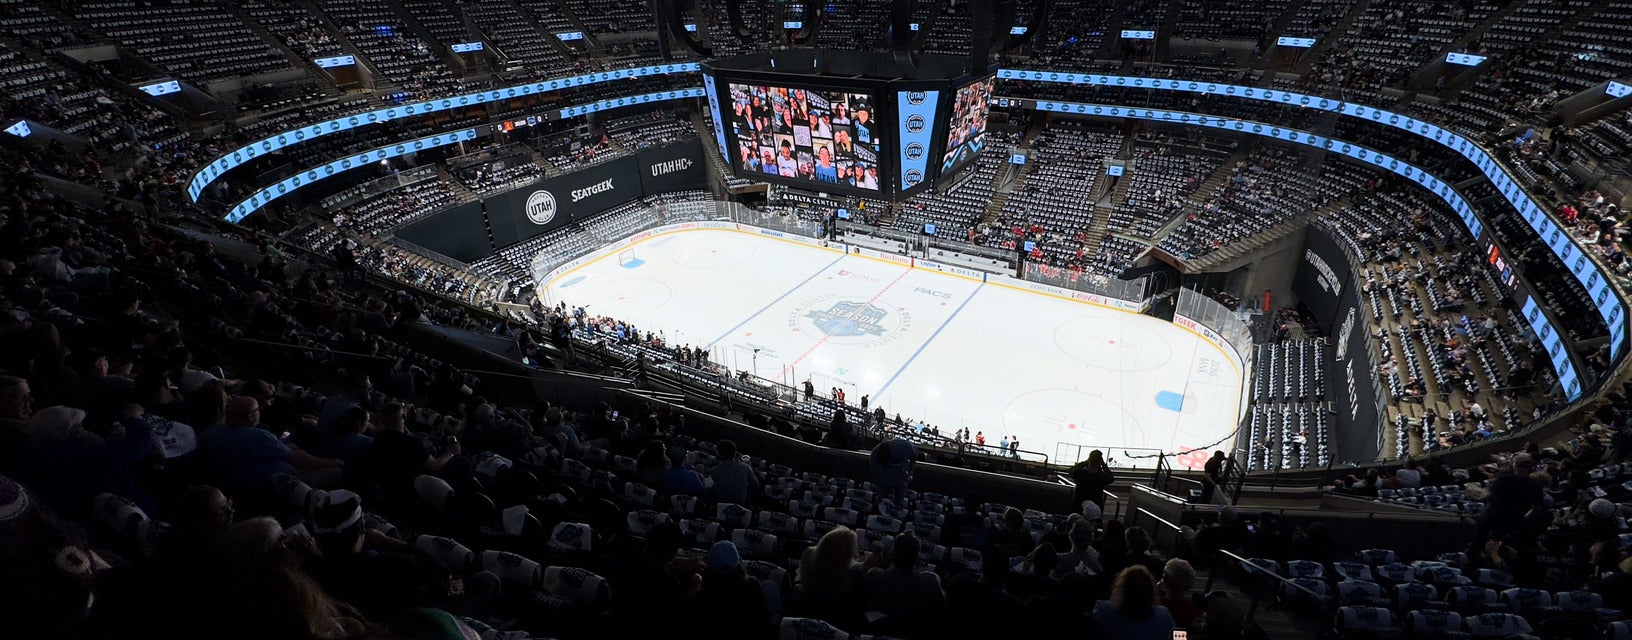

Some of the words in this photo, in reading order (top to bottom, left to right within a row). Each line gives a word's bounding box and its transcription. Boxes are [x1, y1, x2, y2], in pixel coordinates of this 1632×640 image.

[910, 91, 925, 100] UTAH
[909, 120, 923, 128] UTAH
[908, 148, 922, 156] UTAH
[651, 160, 676, 177] UTAH
[675, 157, 693, 172] HC+
[907, 173, 921, 182] UTAH
[571, 178, 614, 202] SEATGEEK
[789, 194, 811, 203] DELTA
[812, 198, 838, 207] CENTER
[531, 199, 553, 216] UTAH
[956, 268, 980, 278] DELTA
[914, 286, 953, 300] PACS
[829, 308, 879, 325] SEASON
